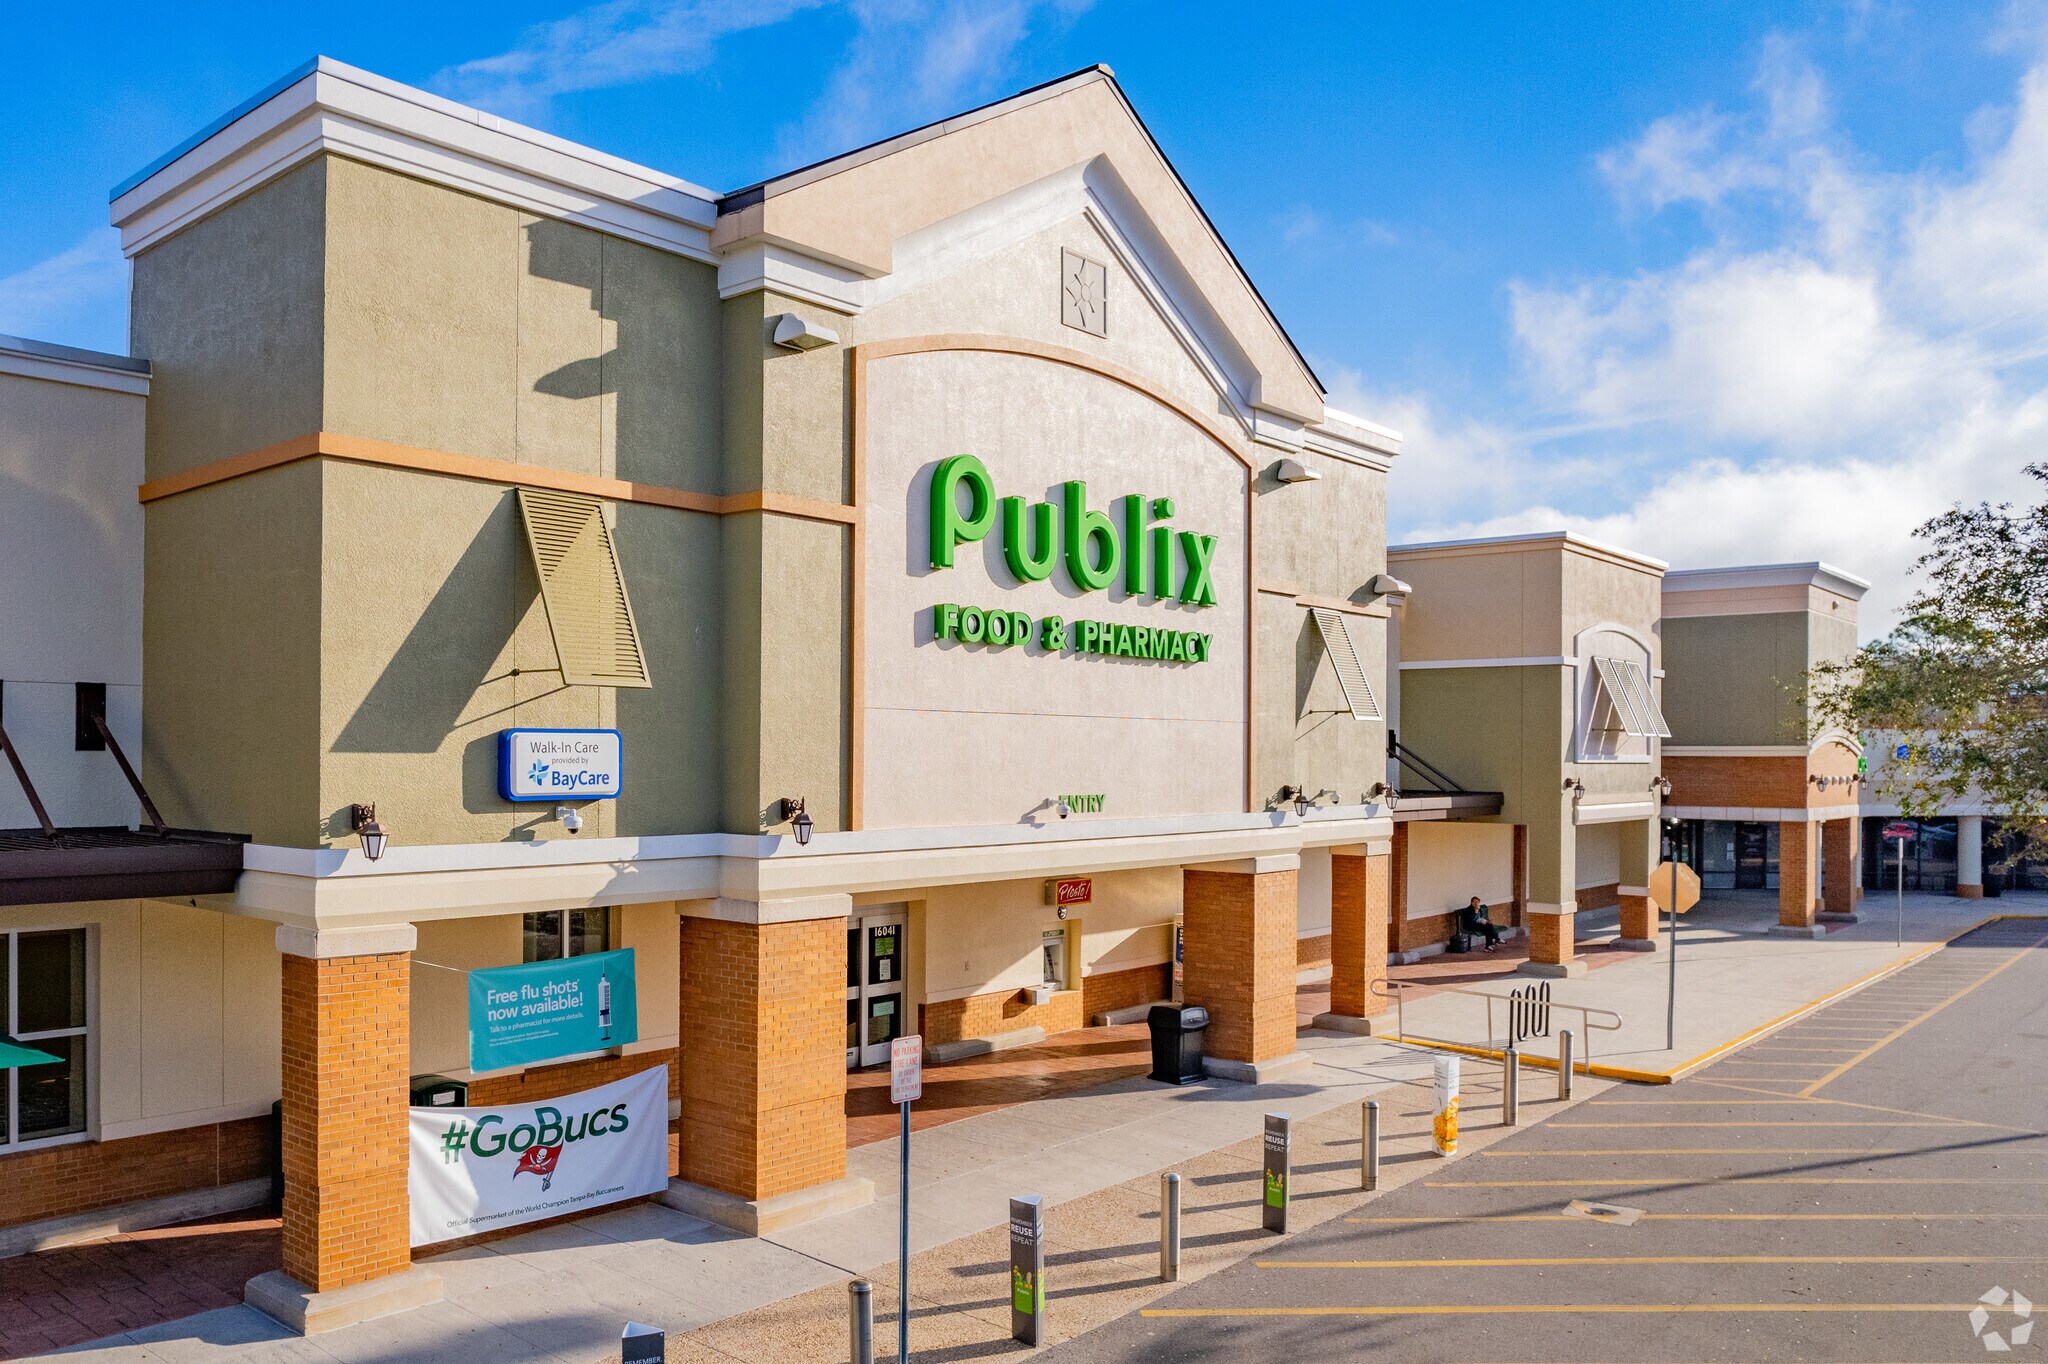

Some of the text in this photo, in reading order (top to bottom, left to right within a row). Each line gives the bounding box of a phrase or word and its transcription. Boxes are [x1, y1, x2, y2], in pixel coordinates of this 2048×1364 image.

[929, 454, 1218, 606] Publix
[934, 603, 1213, 662] FOOD & PHARMACY
[530, 741, 599, 754] Walk-In Care
[551, 757, 589, 765] provided by
[552, 771, 610, 790] BayCare
[874, 925, 896, 937] 16041
[487, 989, 518, 1006] Free
[521, 984, 540, 1000] flu
[488, 992, 584, 1022] now available!
[512, 1020, 543, 1031] pharmacist
[440, 1103, 630, 1165] #GoBucs
[446, 1217, 469, 1228] Official
[469, 1212, 507, 1224] Supermarket
[524, 1203, 542, 1213] World
[541, 1198, 570, 1210] Champion
[569, 1195, 586, 1204] Tampa
[586, 1191, 596, 1199] Bay
[595, 1185, 625, 1197] Buccaneers
[1010, 1223, 1034, 1237] REUSE
